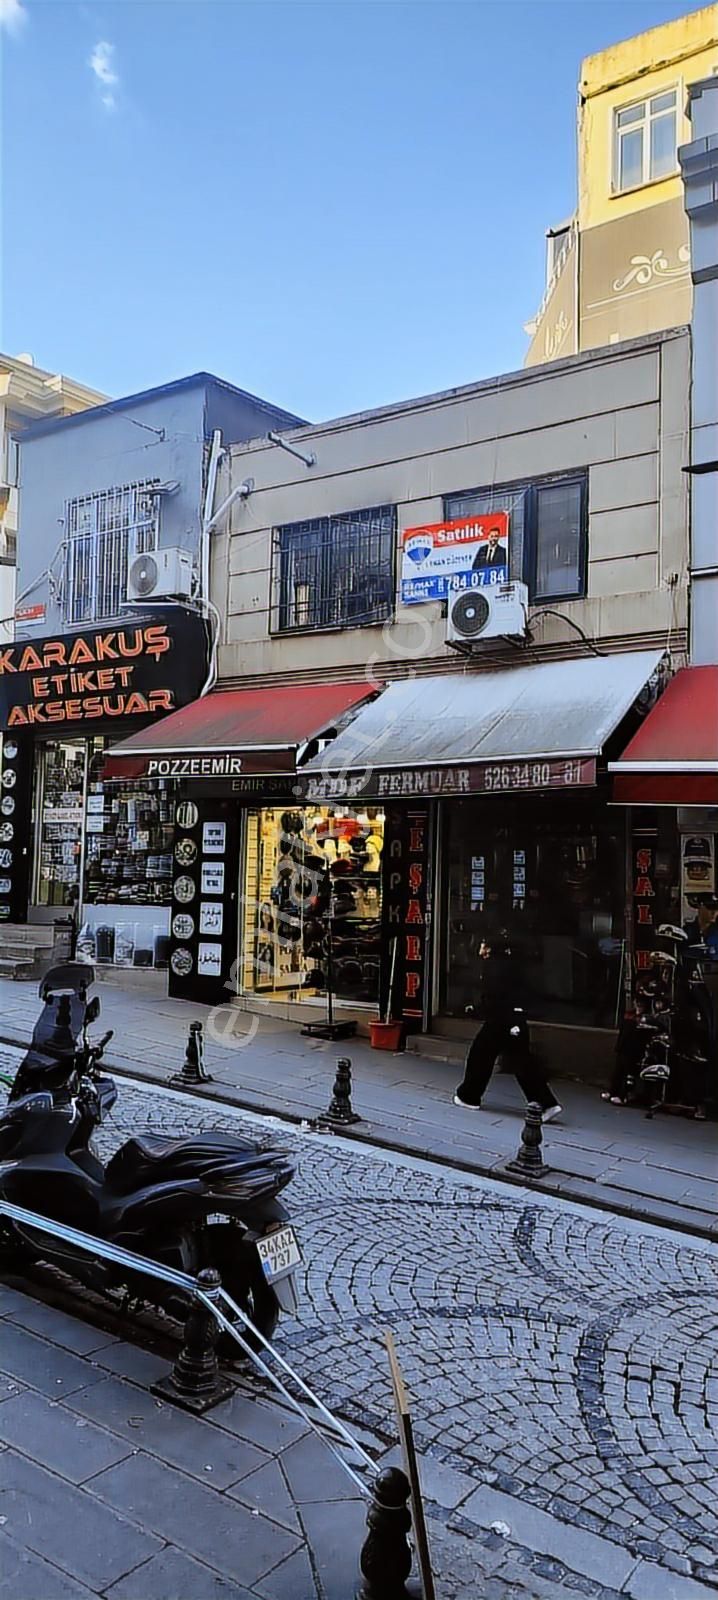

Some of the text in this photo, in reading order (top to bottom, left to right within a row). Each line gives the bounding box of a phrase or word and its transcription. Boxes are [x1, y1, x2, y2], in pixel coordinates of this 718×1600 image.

[437, 524, 484, 543] Satılık
[446, 573, 467, 594] 784
[471, 571, 485, 586] 07
[490, 567, 504, 583] 84
[0, 625, 170, 674] KARAKUŞ
[7, 689, 175, 726] AKSESUAR
[147, 754, 242, 775] POZZEEMİR
[378, 768, 470, 796] FERMUAR
[405, 827, 426, 998] EŞARP
[271, 1249, 291, 1271] 737
